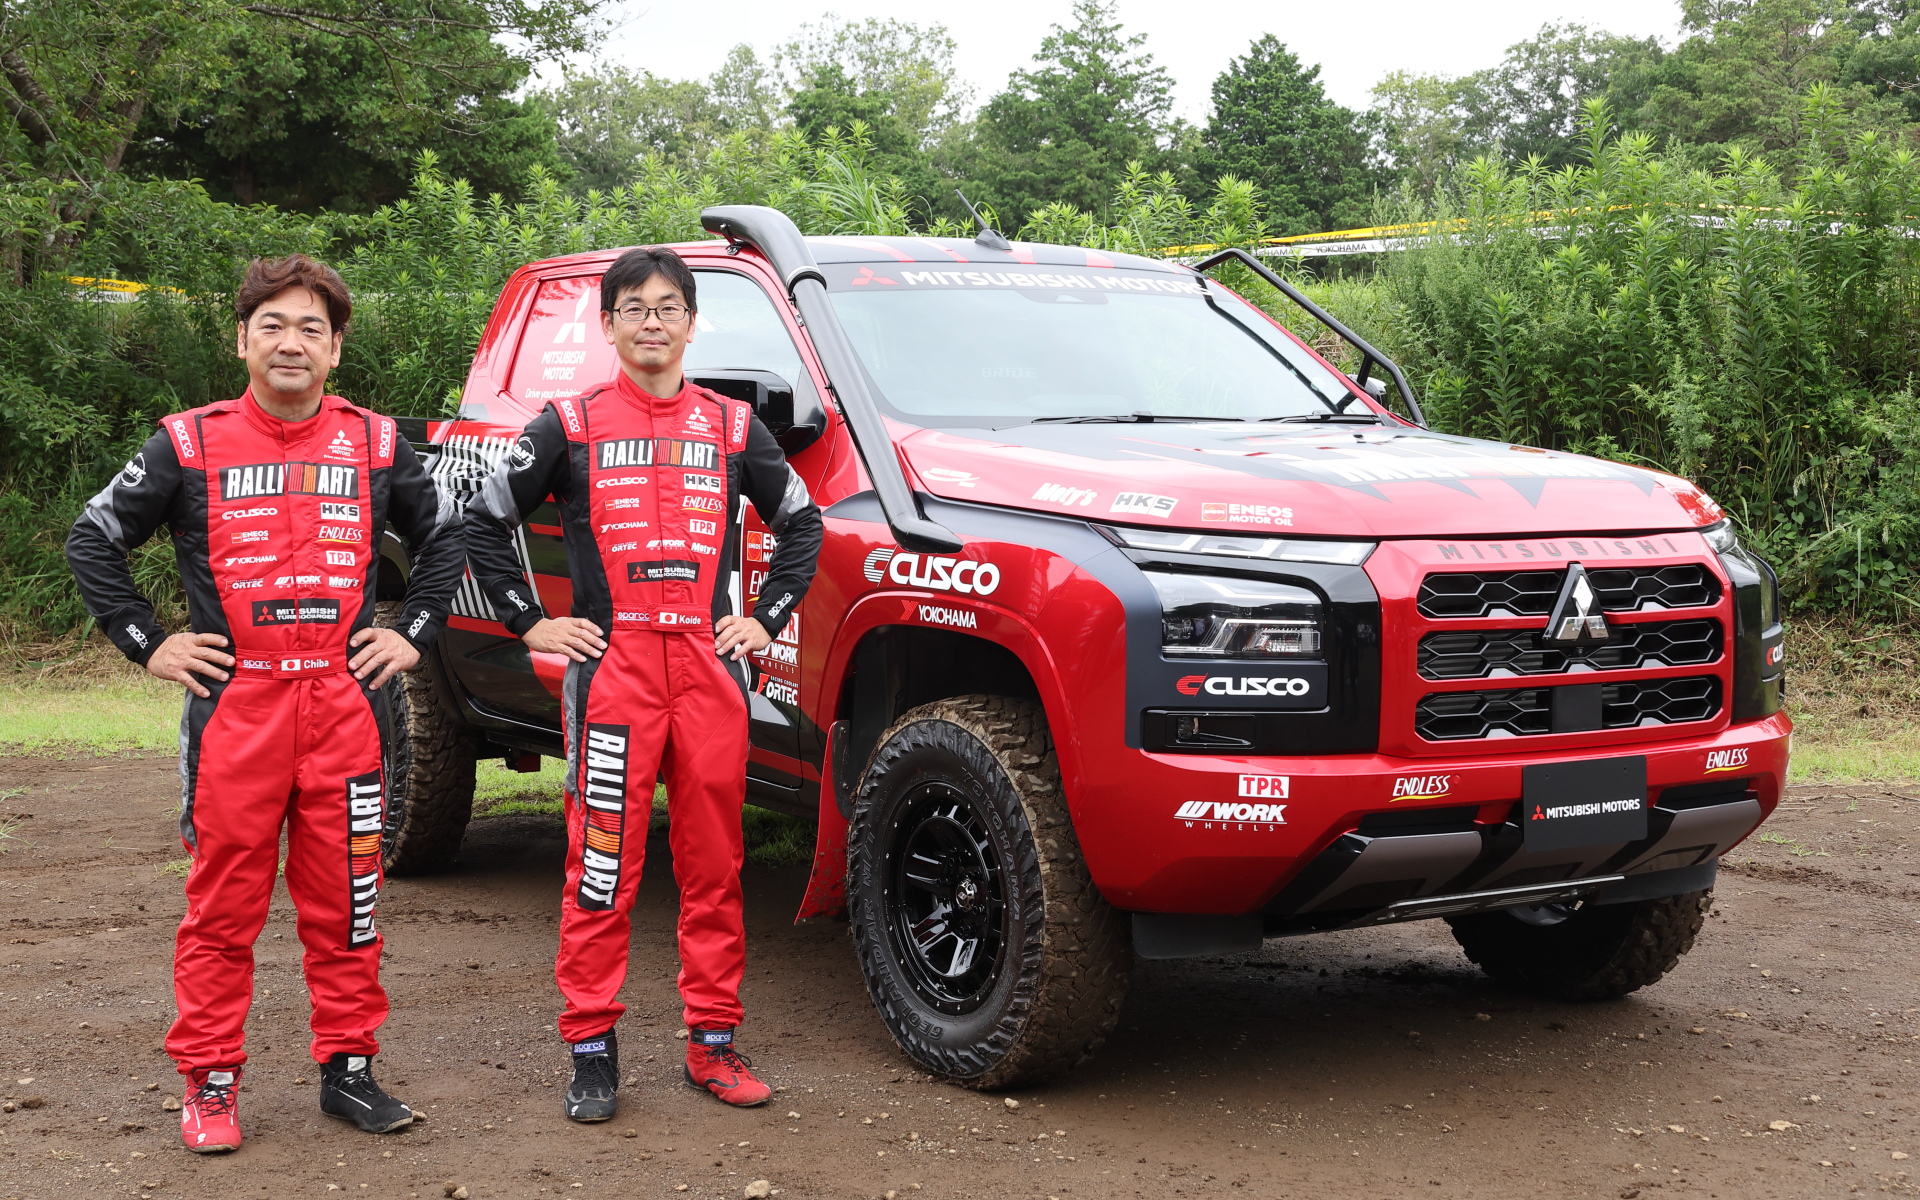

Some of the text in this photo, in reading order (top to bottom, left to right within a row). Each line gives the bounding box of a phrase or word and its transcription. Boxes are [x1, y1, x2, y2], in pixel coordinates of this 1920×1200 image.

[1315, 243, 1367, 253] YOKOHAMA
[900, 271, 1214, 296] MITSUBISHI MOTORS
[541, 350, 586, 364] MITSUBISHI
[542, 367, 576, 380] MOTORS
[981, 367, 1038, 378] BRIDE
[525, 388, 540, 399] Drive
[540, 389, 555, 401] your
[560, 400, 580, 433] sparco
[733, 406, 746, 444] sparco
[173, 420, 195, 458] sparco
[379, 421, 391, 458] sparco
[602, 439, 716, 468] RALLI ART
[226, 464, 355, 498] RALLI ART
[605, 477, 648, 487] CUSCO
[685, 475, 720, 488] HKS
[1032, 482, 1098, 506] Moty's
[322, 503, 358, 517] HKS
[682, 495, 723, 511] ENDLESS
[1114, 493, 1176, 517] HKS
[1228, 503, 1293, 518] ENEOS
[233, 508, 278, 518] CUSCO
[1228, 515, 1293, 526] MOTOR OIL
[610, 521, 648, 530] YOKOHAMA
[692, 520, 713, 534] TPR
[242, 530, 269, 538] ENEOS
[318, 526, 363, 541] ENDLESS
[662, 539, 686, 547] WORK
[691, 542, 717, 555] Moty's
[1437, 537, 1678, 560] MITSUBISHI
[237, 555, 278, 564] YOKOHAMA
[328, 552, 353, 564] TPR
[647, 567, 696, 575] MITSUBISHI
[889, 553, 1001, 596] CUSCO
[296, 575, 322, 584] WORK
[328, 576, 360, 588] Moty's
[276, 608, 337, 616] MITSUBISHI
[768, 592, 793, 619] sparco
[680, 615, 702, 625] Koide
[918, 604, 978, 630] YOKOHAMA
[770, 642, 799, 665] WORK
[304, 659, 329, 669] Chiba
[760, 658, 795, 674] WHEELS
[1204, 676, 1310, 697] CUSCO
[1706, 748, 1749, 769] ENDLESS
[1242, 776, 1284, 797] TPR
[1391, 774, 1451, 797] ENDLESS
[350, 783, 382, 832] ART
[1213, 802, 1288, 822] WORK
[1546, 797, 1641, 820] MITSUBISHI MOTORS
[580, 730, 626, 906] RALLI ART
[1185, 821, 1274, 832] WHEELS
[961, 766, 1021, 921] YOKOHAMA
[864, 898, 944, 1041] GEOLANDAR
[705, 1033, 732, 1043] sparco
[574, 1040, 606, 1053] sparco
